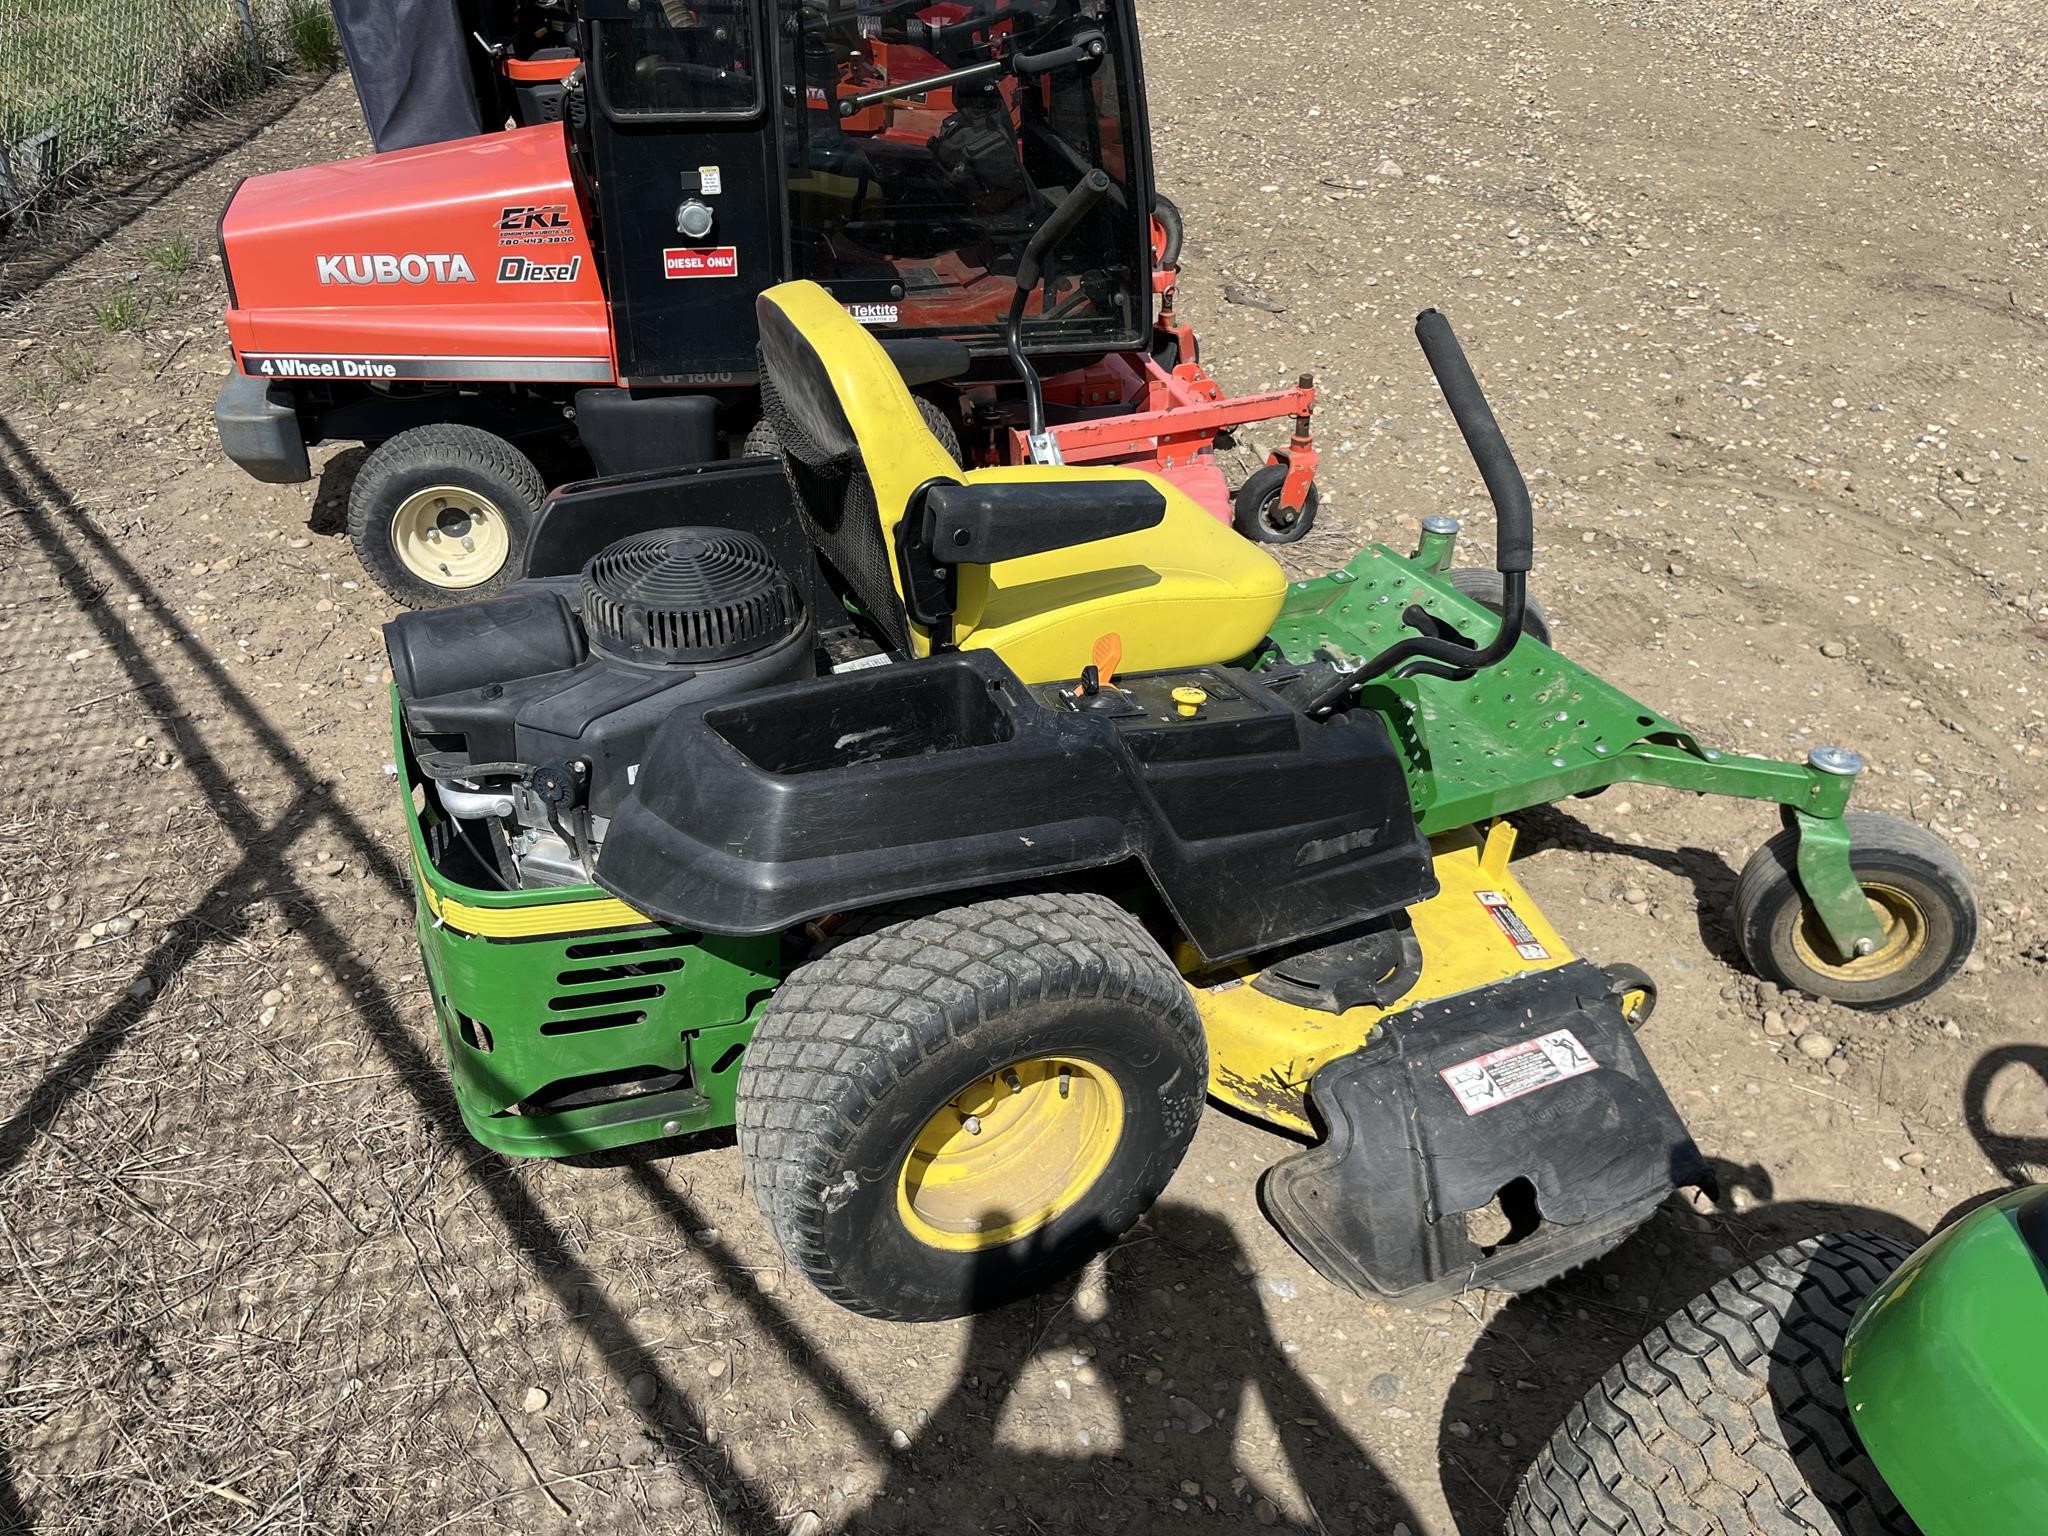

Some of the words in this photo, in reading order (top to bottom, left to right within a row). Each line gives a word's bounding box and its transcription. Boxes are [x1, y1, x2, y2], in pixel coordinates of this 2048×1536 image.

[500, 205, 570, 230] EKL
[500, 236, 575, 246] 780-443-3800
[315, 253, 477, 285] KUBOTA
[498, 257, 580, 281] Diesel
[667, 258, 704, 269] DIESEL
[706, 257, 733, 267] ONLY
[852, 304, 898, 316] Tektite
[260, 360, 274, 375] 4
[275, 360, 340, 376] Wheel
[342, 361, 397, 377] Drive
